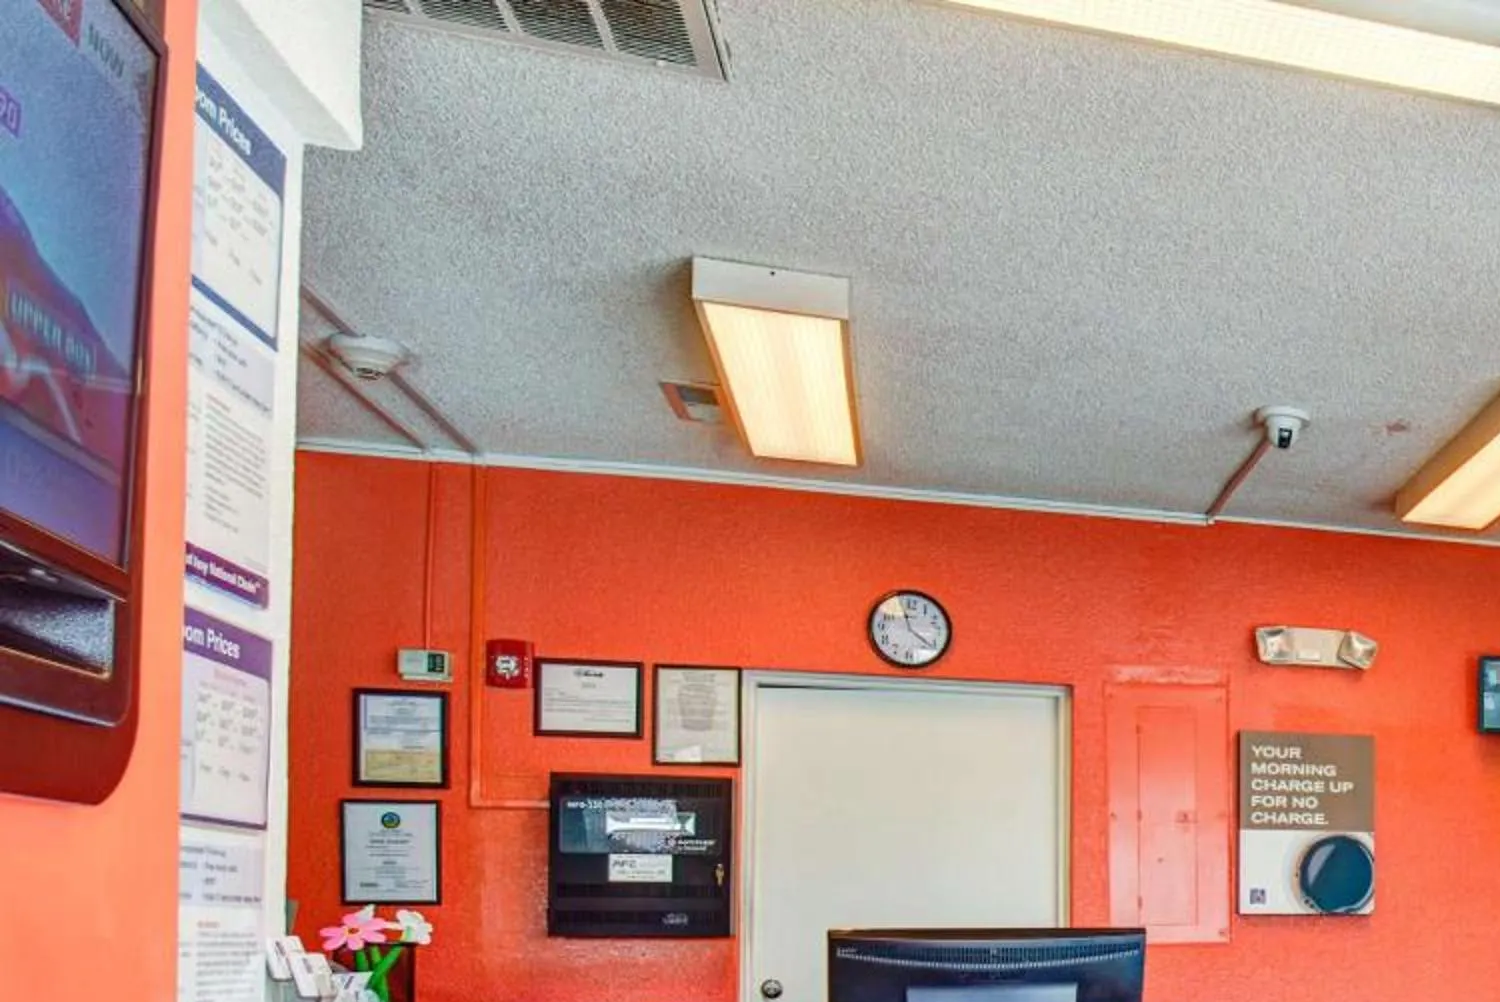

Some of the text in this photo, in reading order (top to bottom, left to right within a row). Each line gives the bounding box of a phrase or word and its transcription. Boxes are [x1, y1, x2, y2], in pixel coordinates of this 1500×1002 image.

[218, 106, 252, 156] Prices
[207, 628, 241, 660] Prices
[1251, 745, 1302, 760] YOUR
[1251, 762, 1337, 777] MORNING
[1251, 778, 1354, 793] CHARGE UP
[1251, 795, 1319, 809] FOR NO
[1251, 811, 1329, 825] CHARGE.
